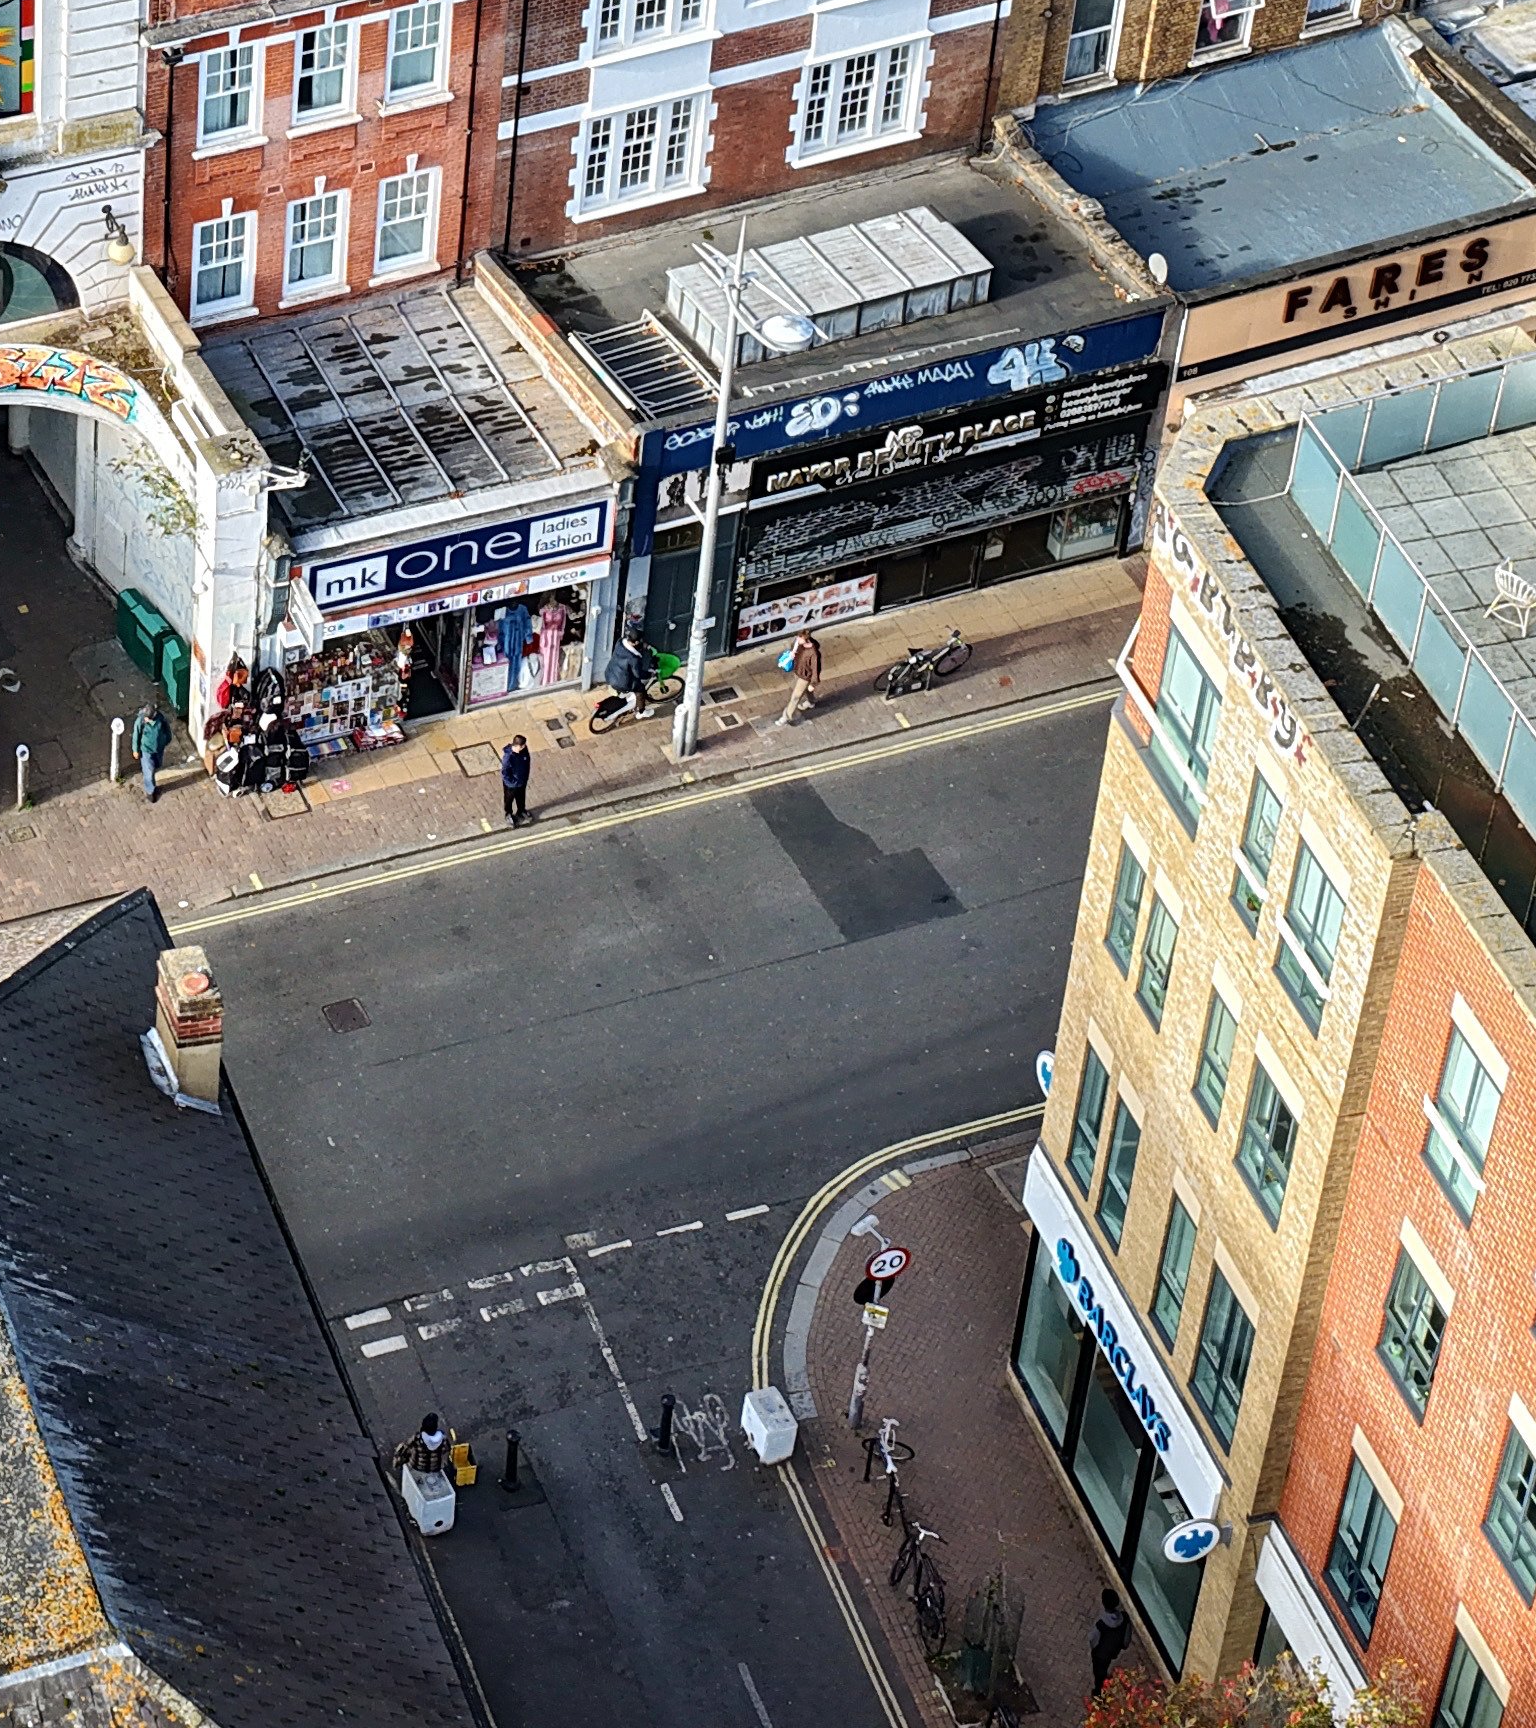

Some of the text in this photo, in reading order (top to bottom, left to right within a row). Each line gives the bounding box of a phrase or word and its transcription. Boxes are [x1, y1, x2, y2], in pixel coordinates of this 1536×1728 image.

[1283, 238, 1490, 324] FARES
[767, 410, 1036, 493] MAYOR BEAUTY PLACE
[535, 529, 593, 553] fashion
[542, 514, 589, 535] ladies
[326, 530, 523, 597] mk one
[874, 1255, 903, 1274] 20
[1076, 1275, 1172, 1452] BARCLAYS
